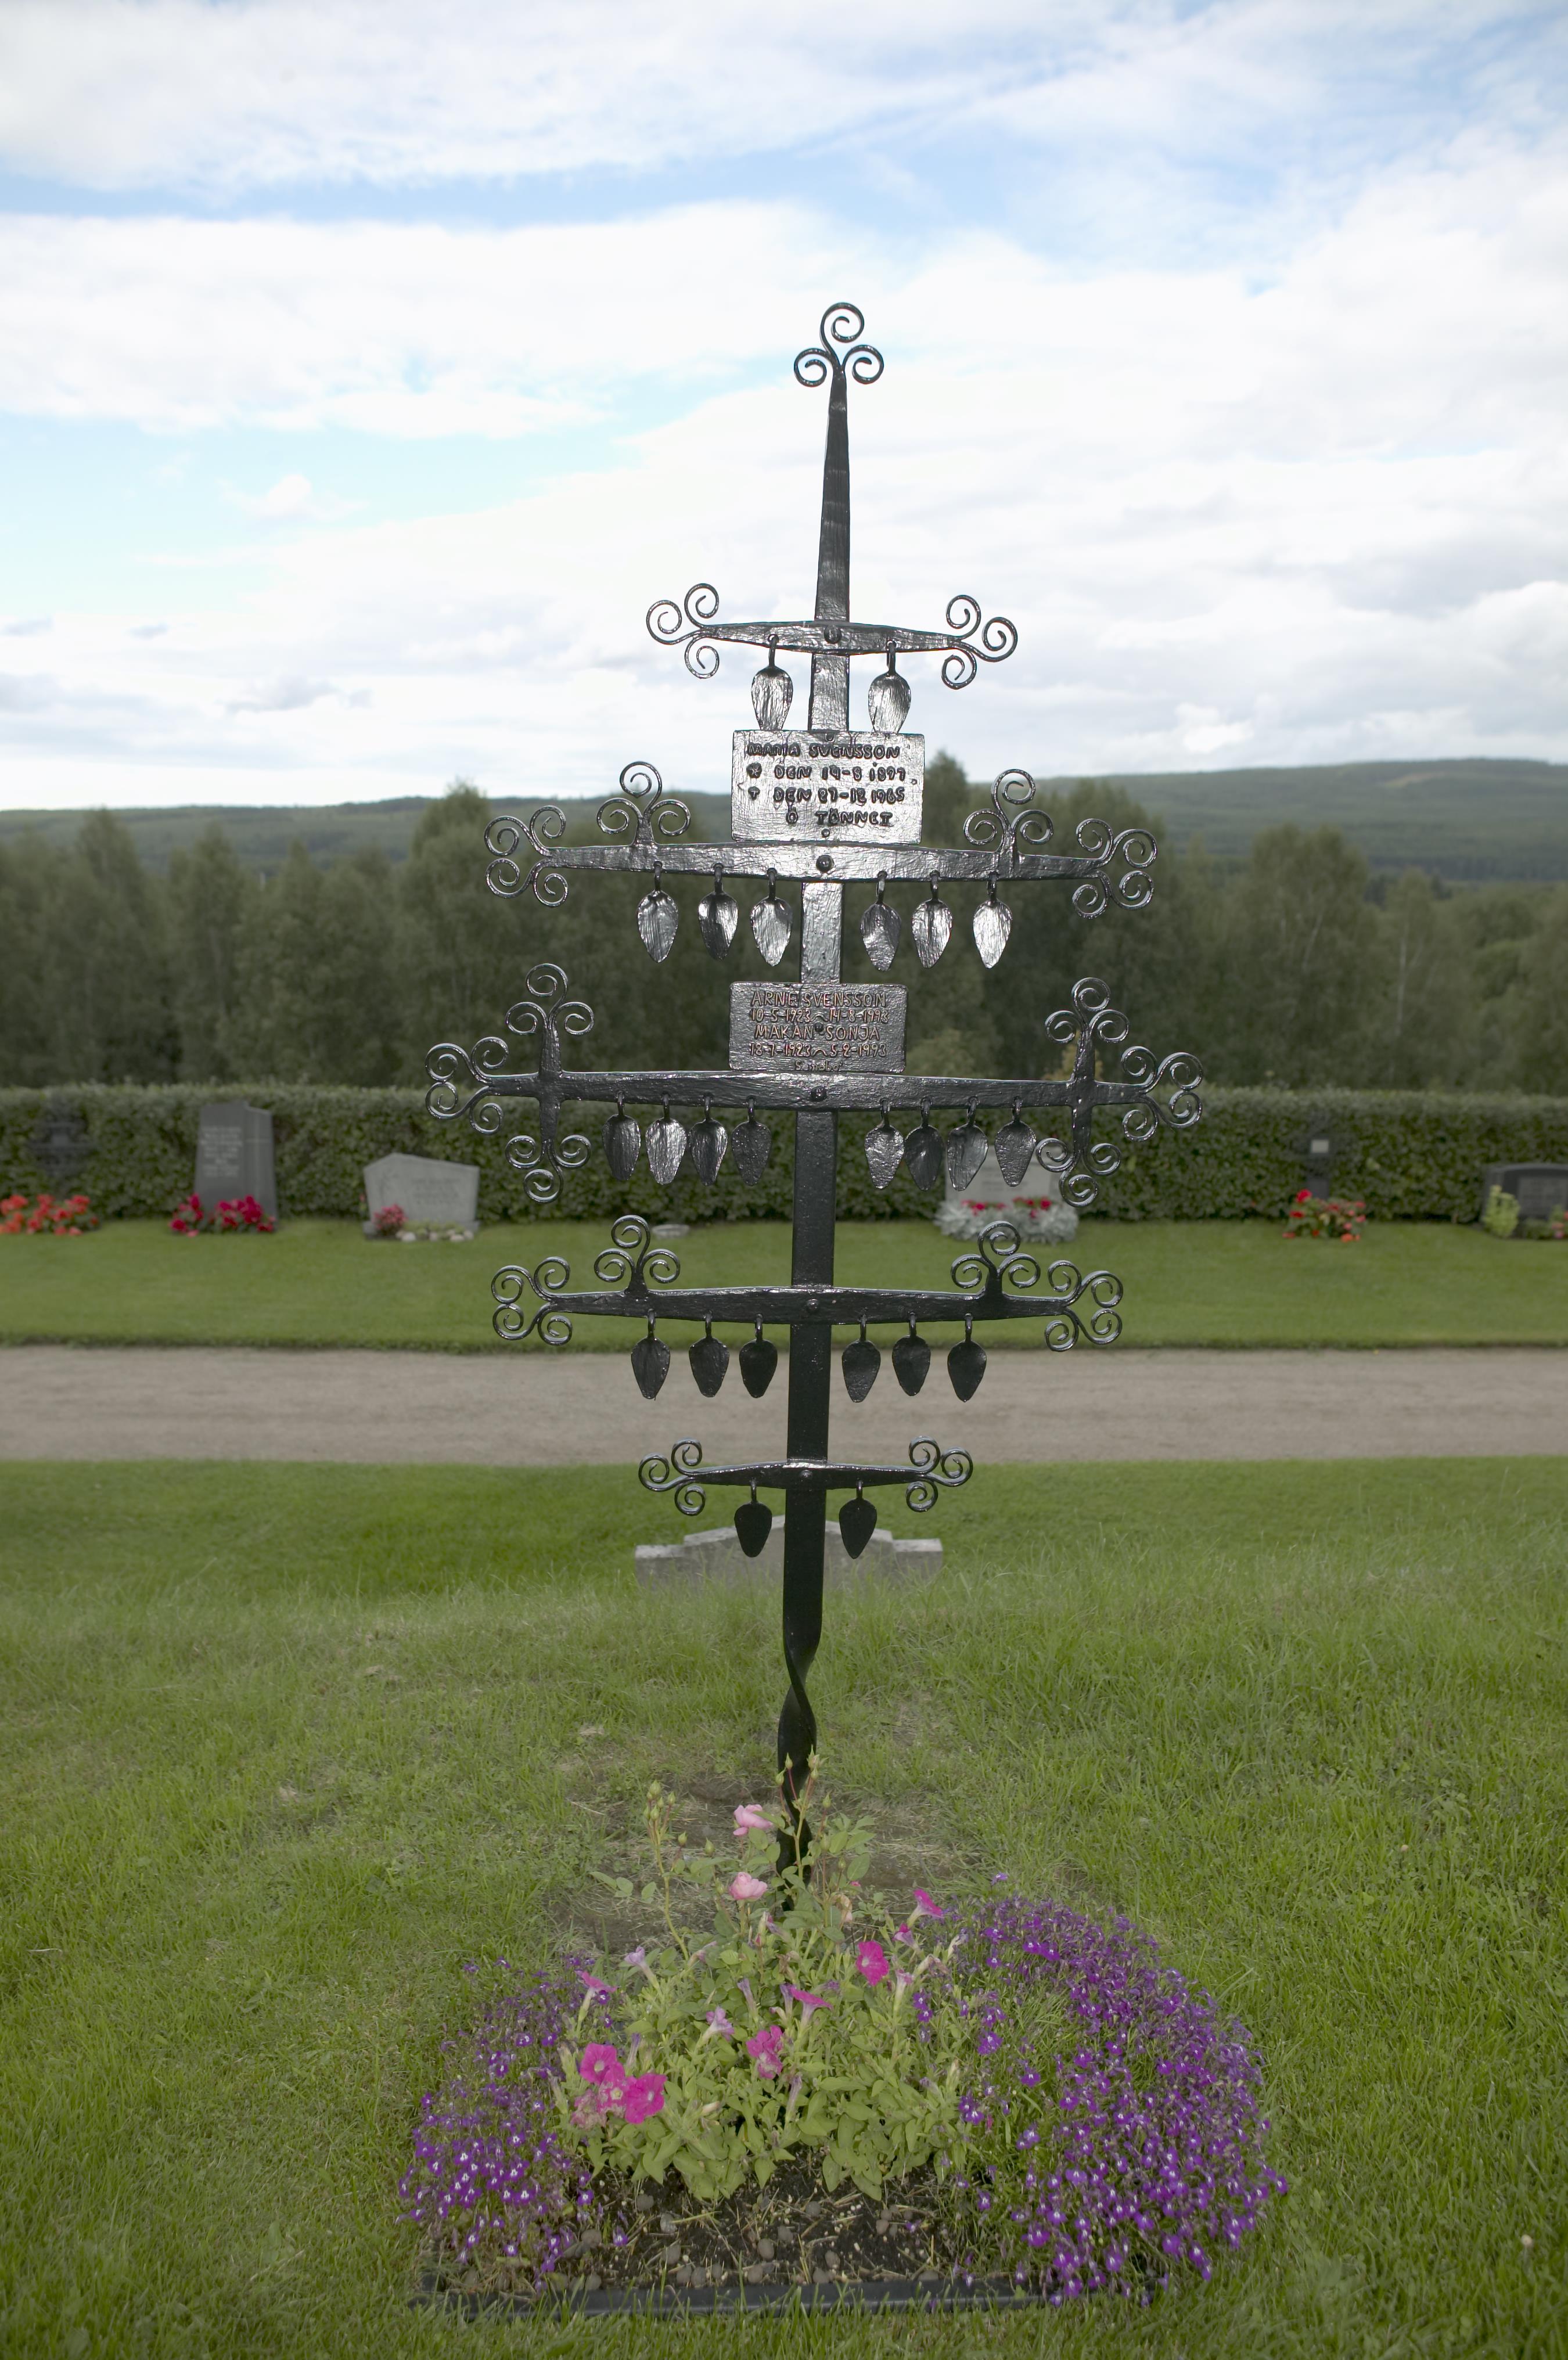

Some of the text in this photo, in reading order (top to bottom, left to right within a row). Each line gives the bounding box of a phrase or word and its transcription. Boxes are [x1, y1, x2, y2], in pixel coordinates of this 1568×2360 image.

[808, 743, 900, 759] SVENSSON
[774, 765, 812, 779] DEN
[773, 787, 812, 802] DEN
[871, 786, 905, 804] 1965
[751, 990, 886, 1008] ARNE SVENSSON
[754, 1023, 880, 1041] MAKAN SONJA
